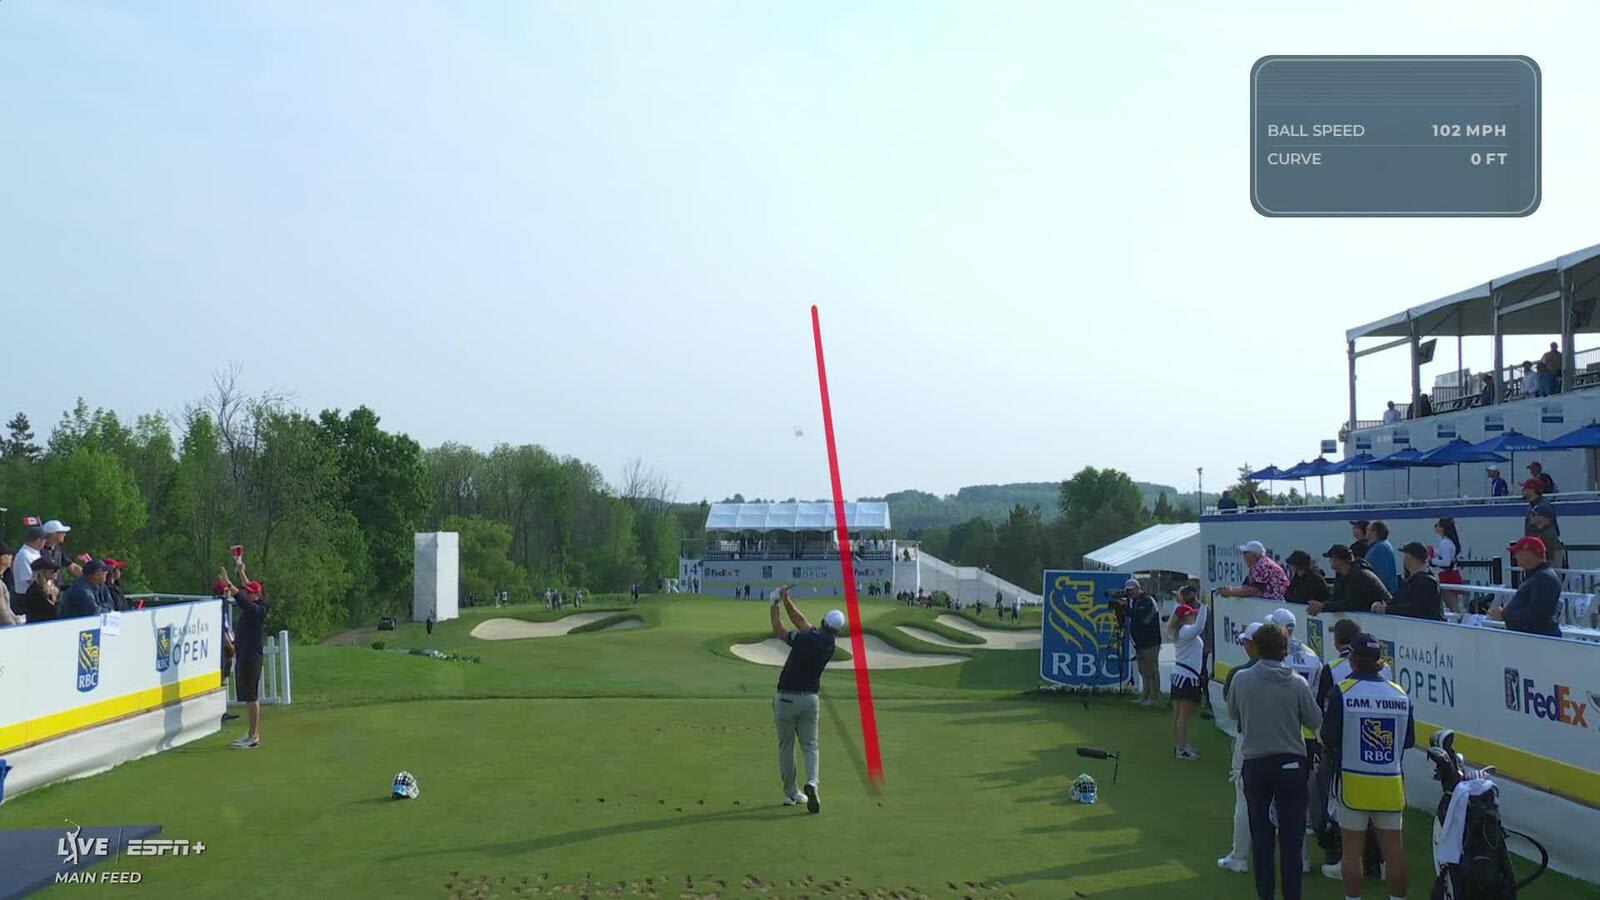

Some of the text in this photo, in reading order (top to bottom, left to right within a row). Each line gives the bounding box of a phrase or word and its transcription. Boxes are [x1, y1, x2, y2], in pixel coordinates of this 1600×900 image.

[682, 564, 698, 576] 14
[1217, 561, 1243, 583] OPEN
[173, 617, 209, 638] CANADIAN
[172, 638, 209, 666] OPEN
[1399, 643, 1454, 670] CANADIAN
[1052, 652, 1121, 678] RBC
[79, 672, 98, 688] RBC
[1399, 668, 1455, 708] OPEN
[1375, 699, 1408, 711] YOUNG
[1523, 678, 1588, 728] FedEx
[1364, 750, 1393, 762] RBC
